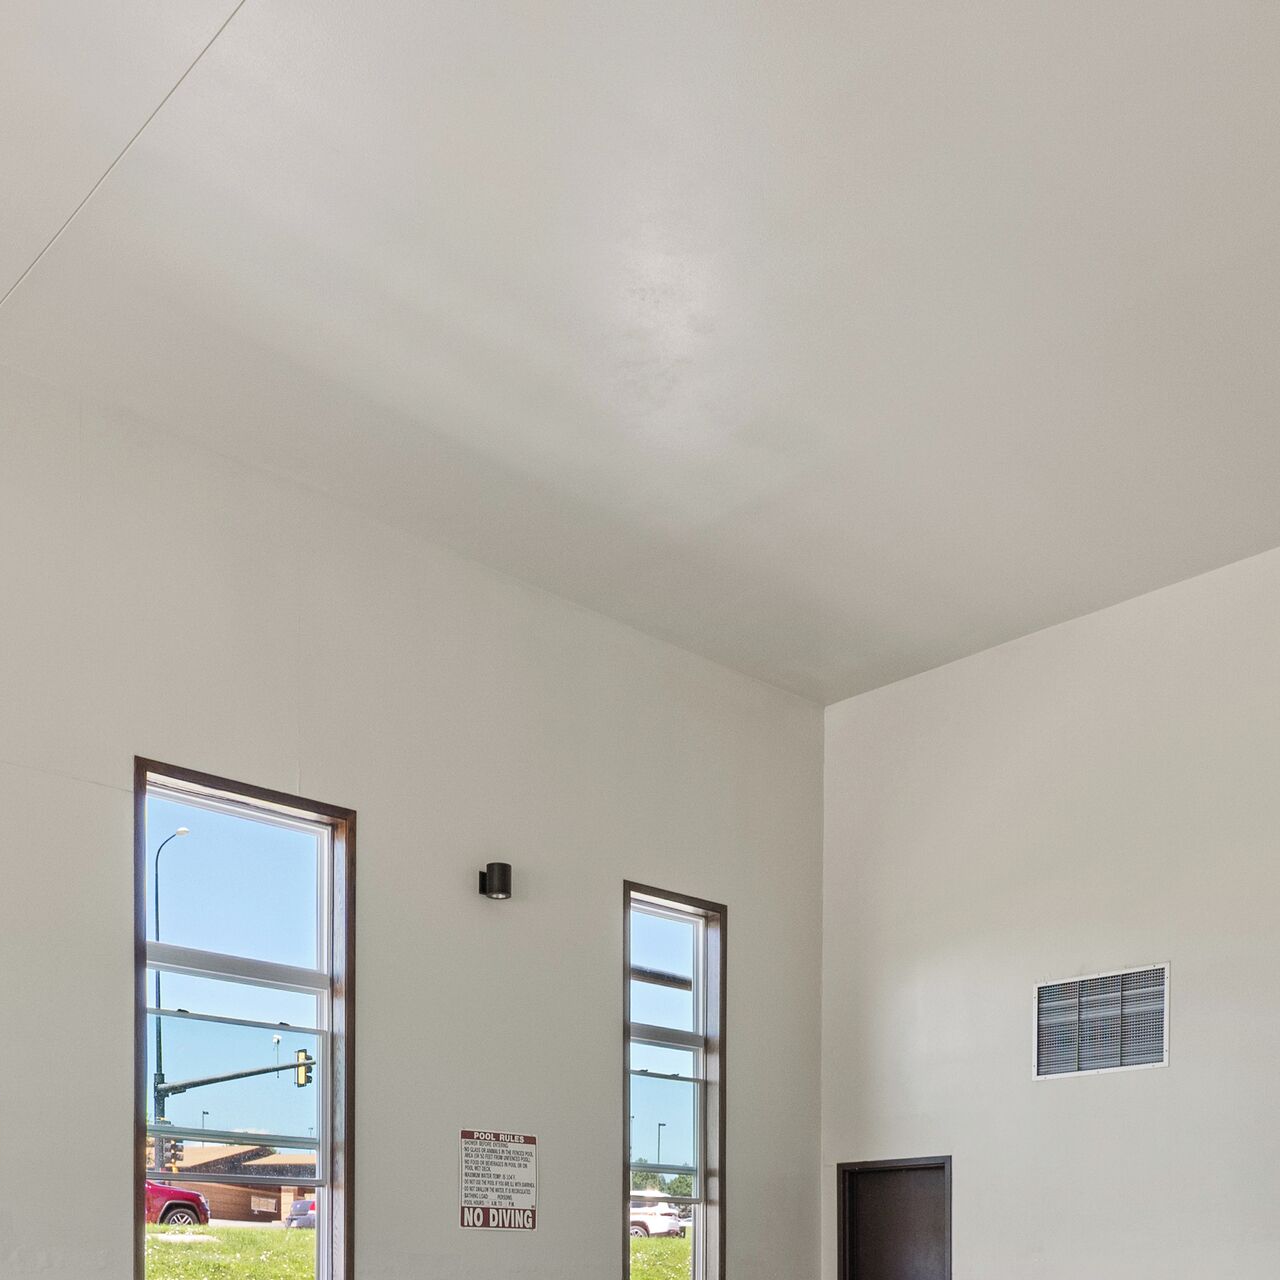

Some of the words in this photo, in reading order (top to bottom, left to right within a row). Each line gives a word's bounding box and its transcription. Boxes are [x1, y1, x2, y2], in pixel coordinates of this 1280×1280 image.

[500, 1134, 524, 1143] RULES
[464, 1208, 483, 1226] NO
[490, 1209, 532, 1228] DIVING
